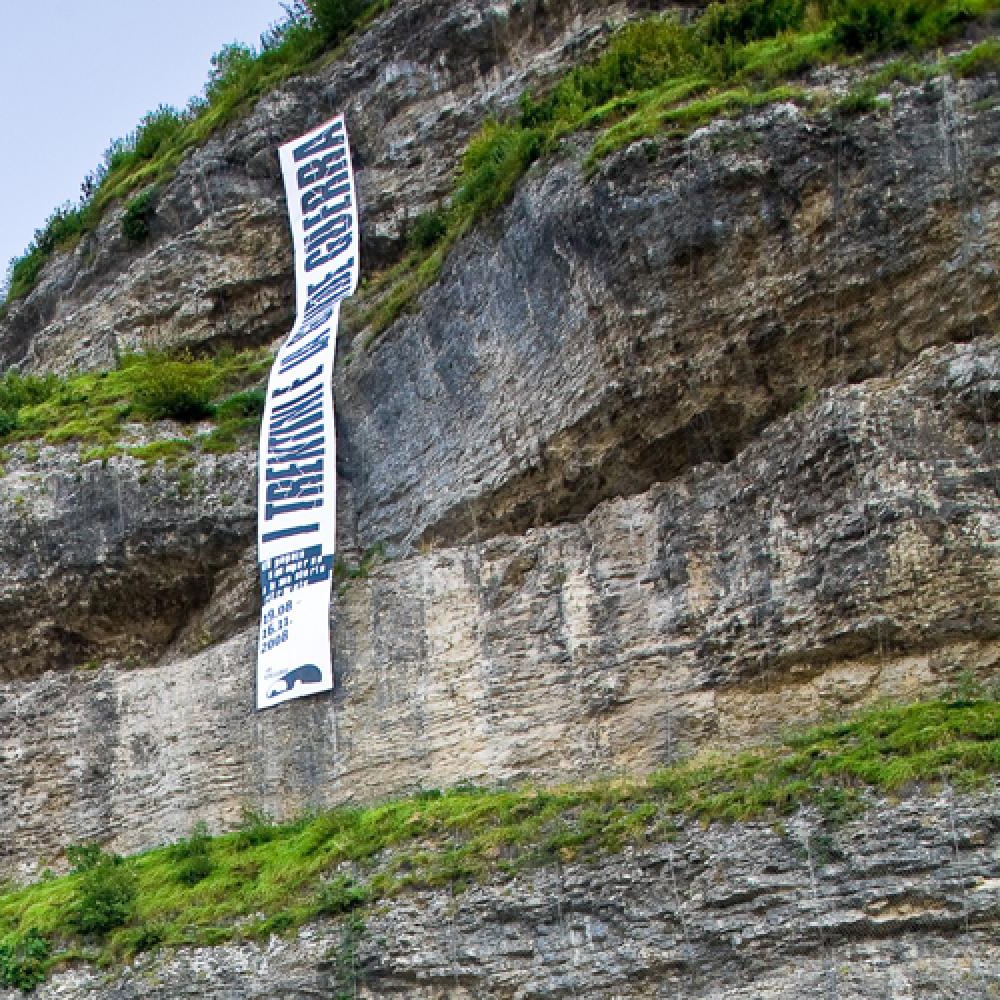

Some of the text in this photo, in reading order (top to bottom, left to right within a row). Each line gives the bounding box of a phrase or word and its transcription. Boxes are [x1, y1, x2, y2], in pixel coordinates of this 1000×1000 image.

[293, 121, 355, 272] GUERRA
[278, 328, 331, 375] LA
[271, 363, 324, 399] E
[264, 383, 325, 521] TRENTINI
[262, 522, 320, 544] I
[261, 629, 289, 655] 2008
